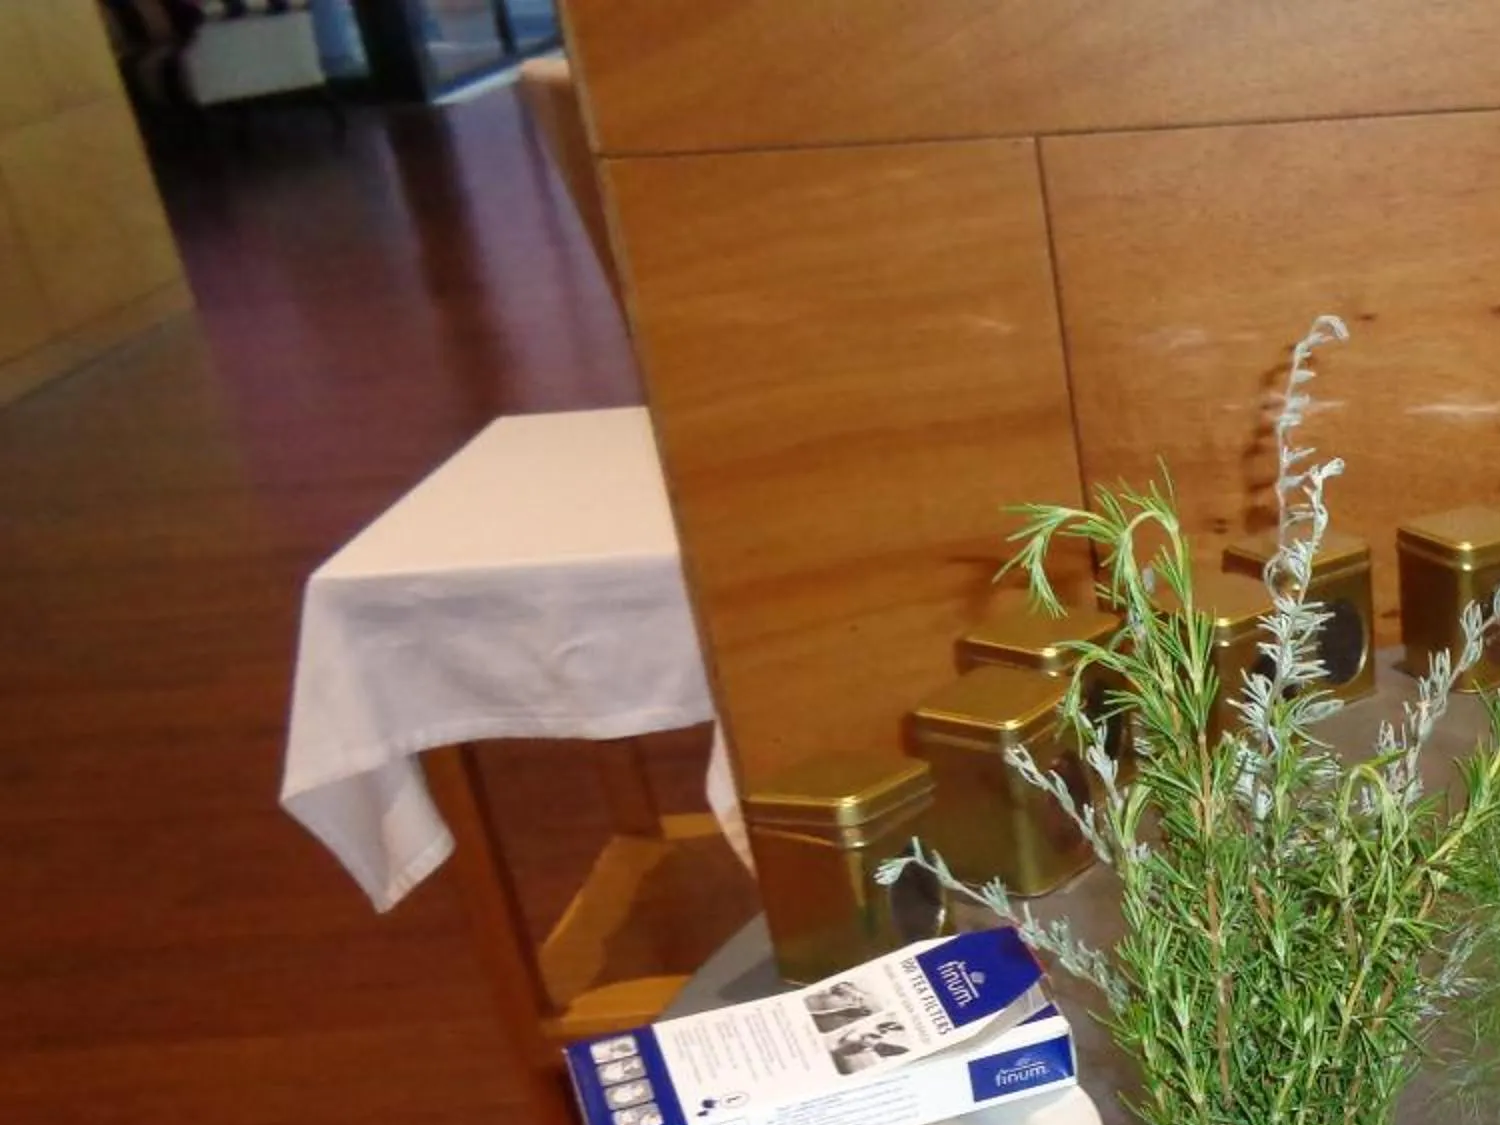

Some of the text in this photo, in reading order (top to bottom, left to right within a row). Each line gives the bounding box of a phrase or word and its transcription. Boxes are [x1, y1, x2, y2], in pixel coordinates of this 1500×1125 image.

[911, 975, 929, 994] TEA
[920, 993, 954, 1036] FILTERS
[936, 959, 976, 1009] finum
[994, 1064, 1049, 1088] finum
